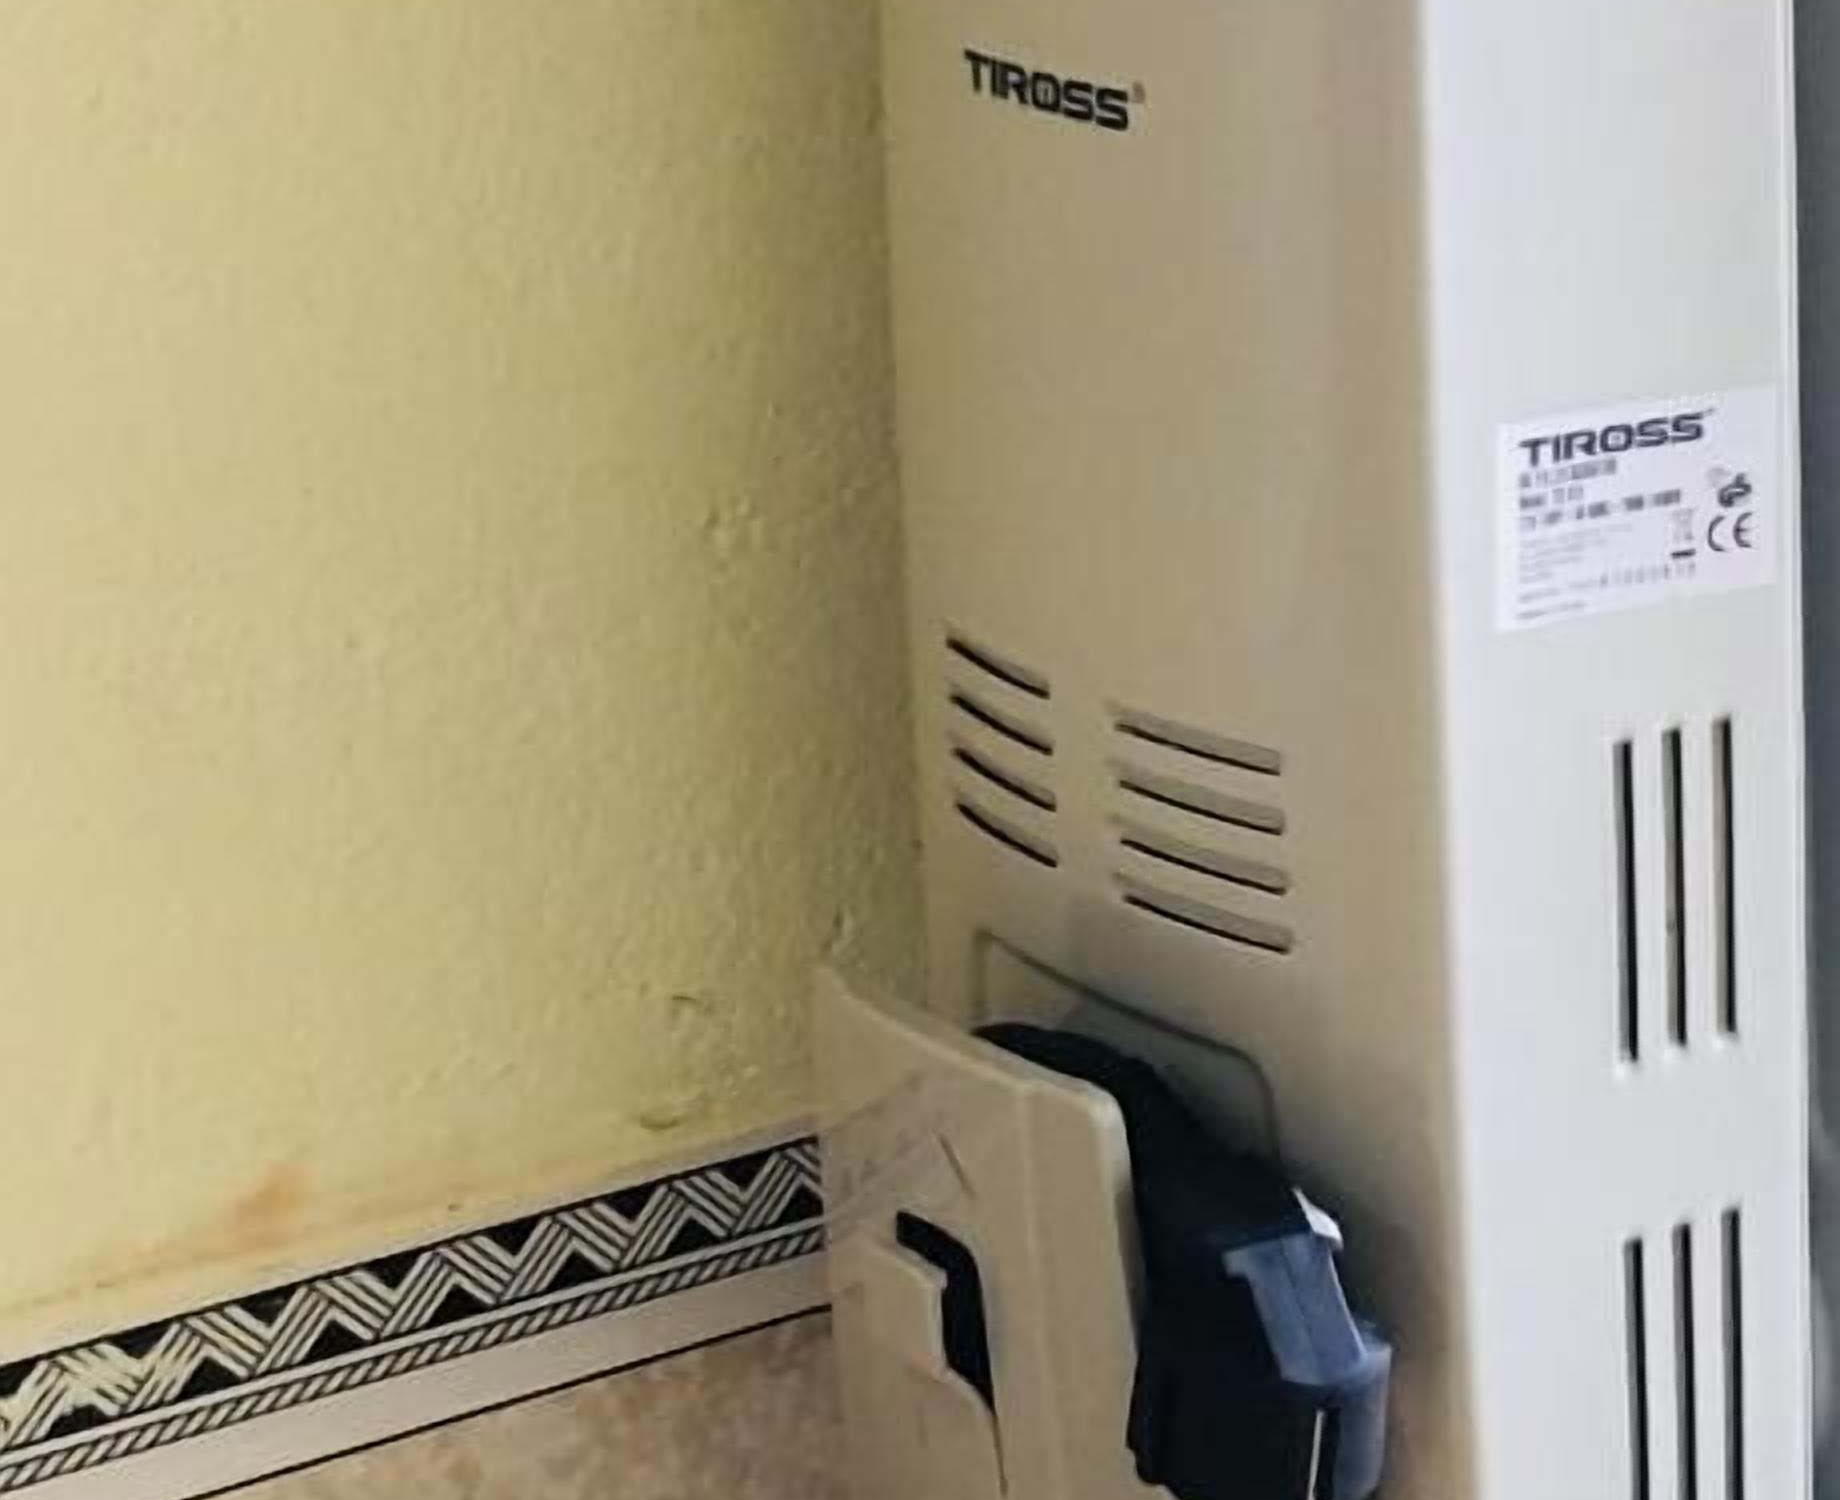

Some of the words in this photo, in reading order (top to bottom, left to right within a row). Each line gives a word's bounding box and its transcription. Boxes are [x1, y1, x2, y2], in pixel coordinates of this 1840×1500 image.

[964, 48, 1129, 131] TIROSS
[1519, 412, 1704, 467] TIROSS
[1707, 511, 1753, 551] CE
